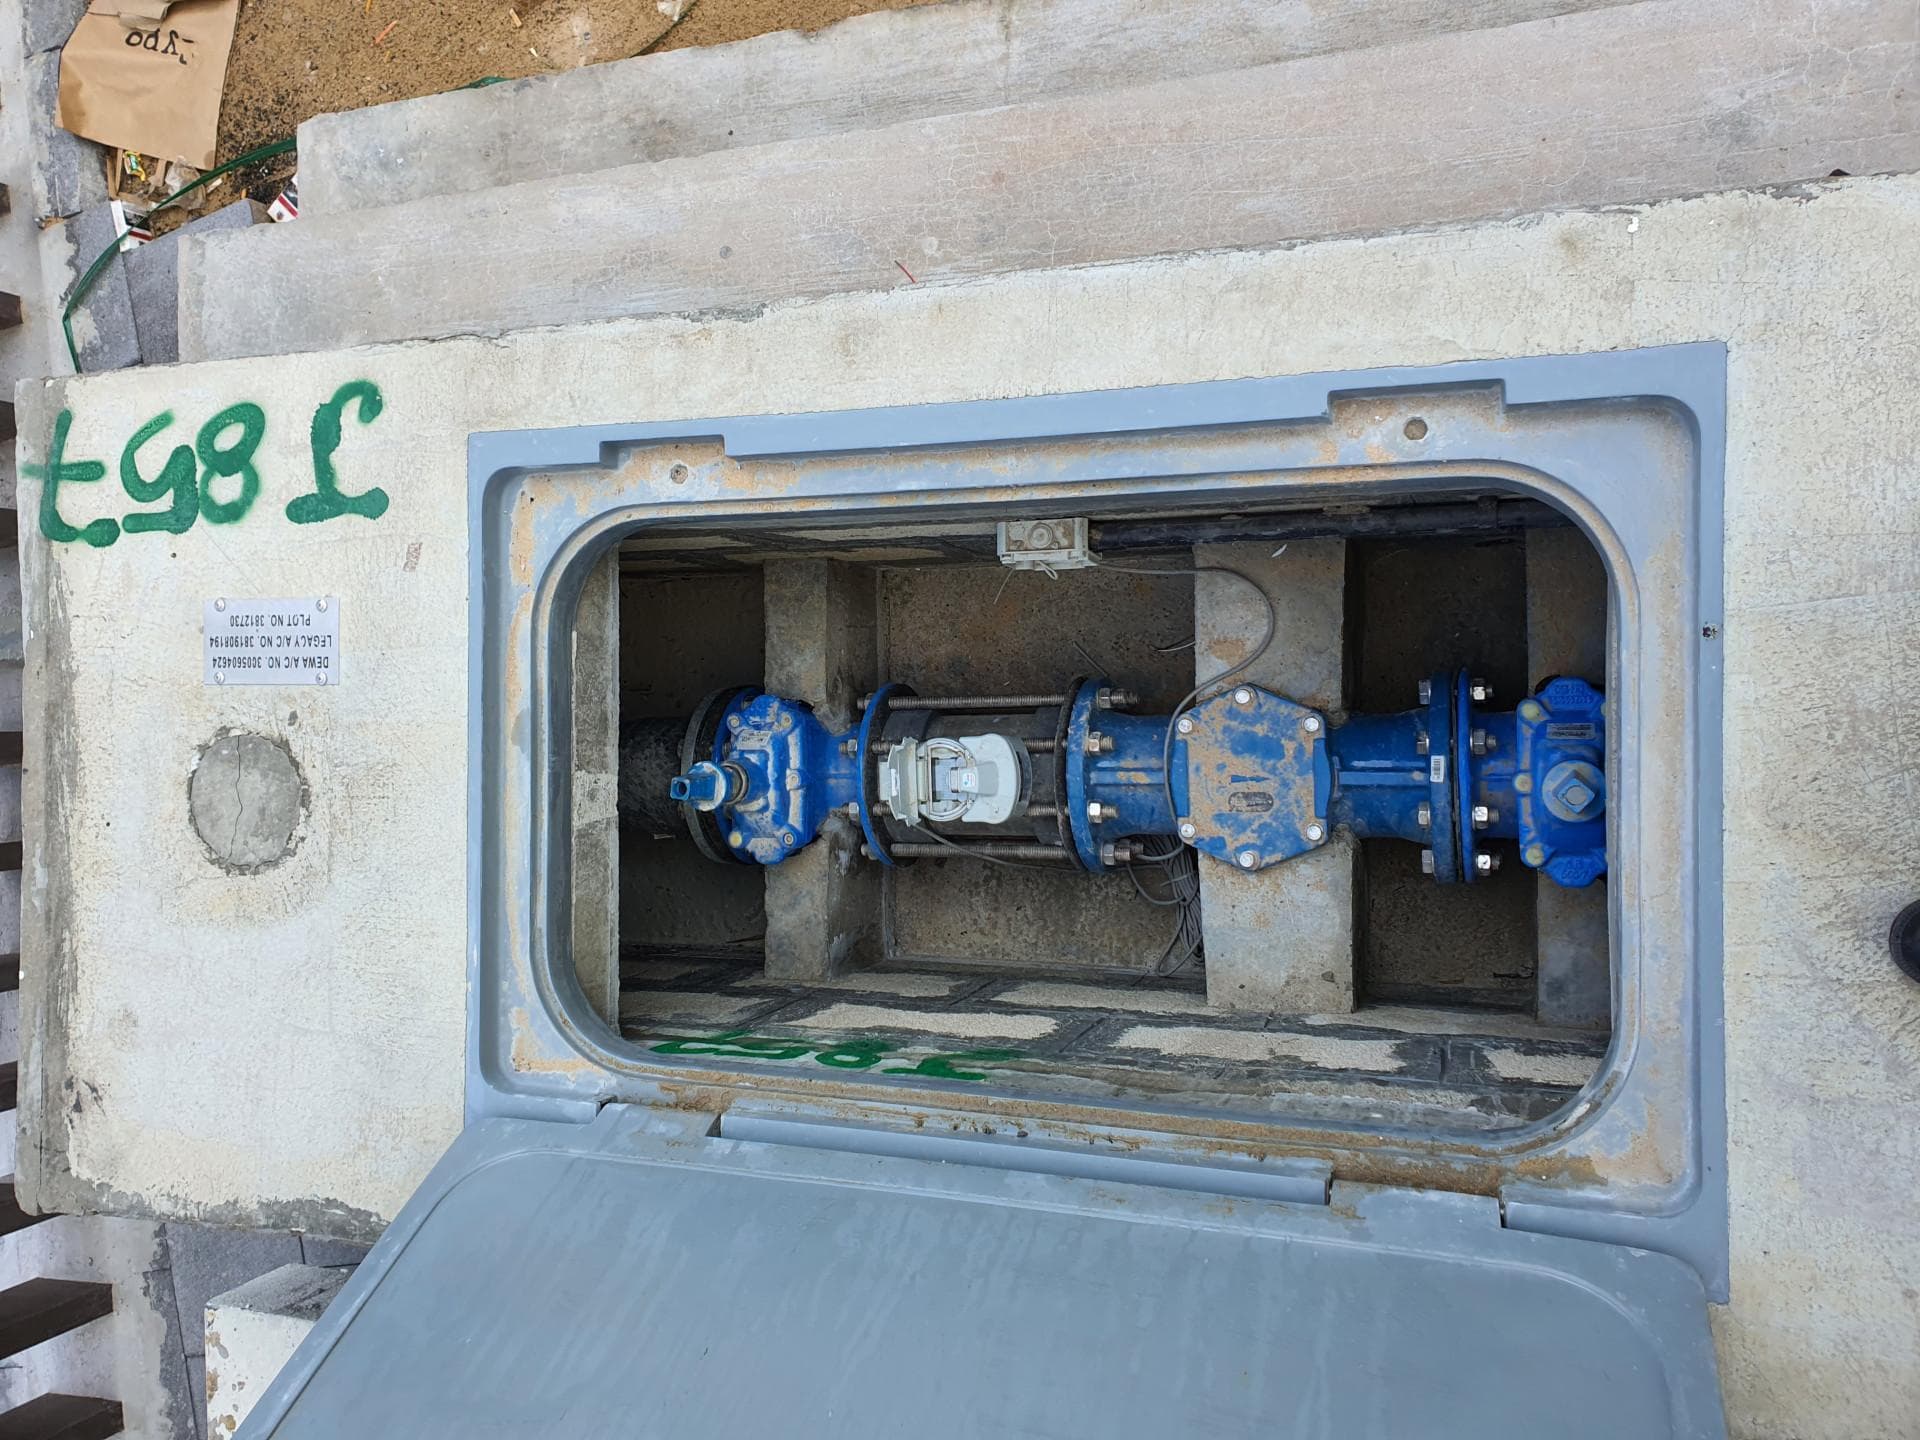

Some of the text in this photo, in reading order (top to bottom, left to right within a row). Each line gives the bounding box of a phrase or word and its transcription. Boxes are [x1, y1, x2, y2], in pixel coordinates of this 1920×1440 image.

[229, 614, 311, 627] PLOT NO. 3812730
[257, 635, 273, 648] NO.
[276, 635, 292, 648] A/C
[294, 634, 332, 648] LEGACY
[265, 656, 281, 669] NO.
[284, 656, 299, 669] A/C
[302, 656, 329, 669] DEWA
